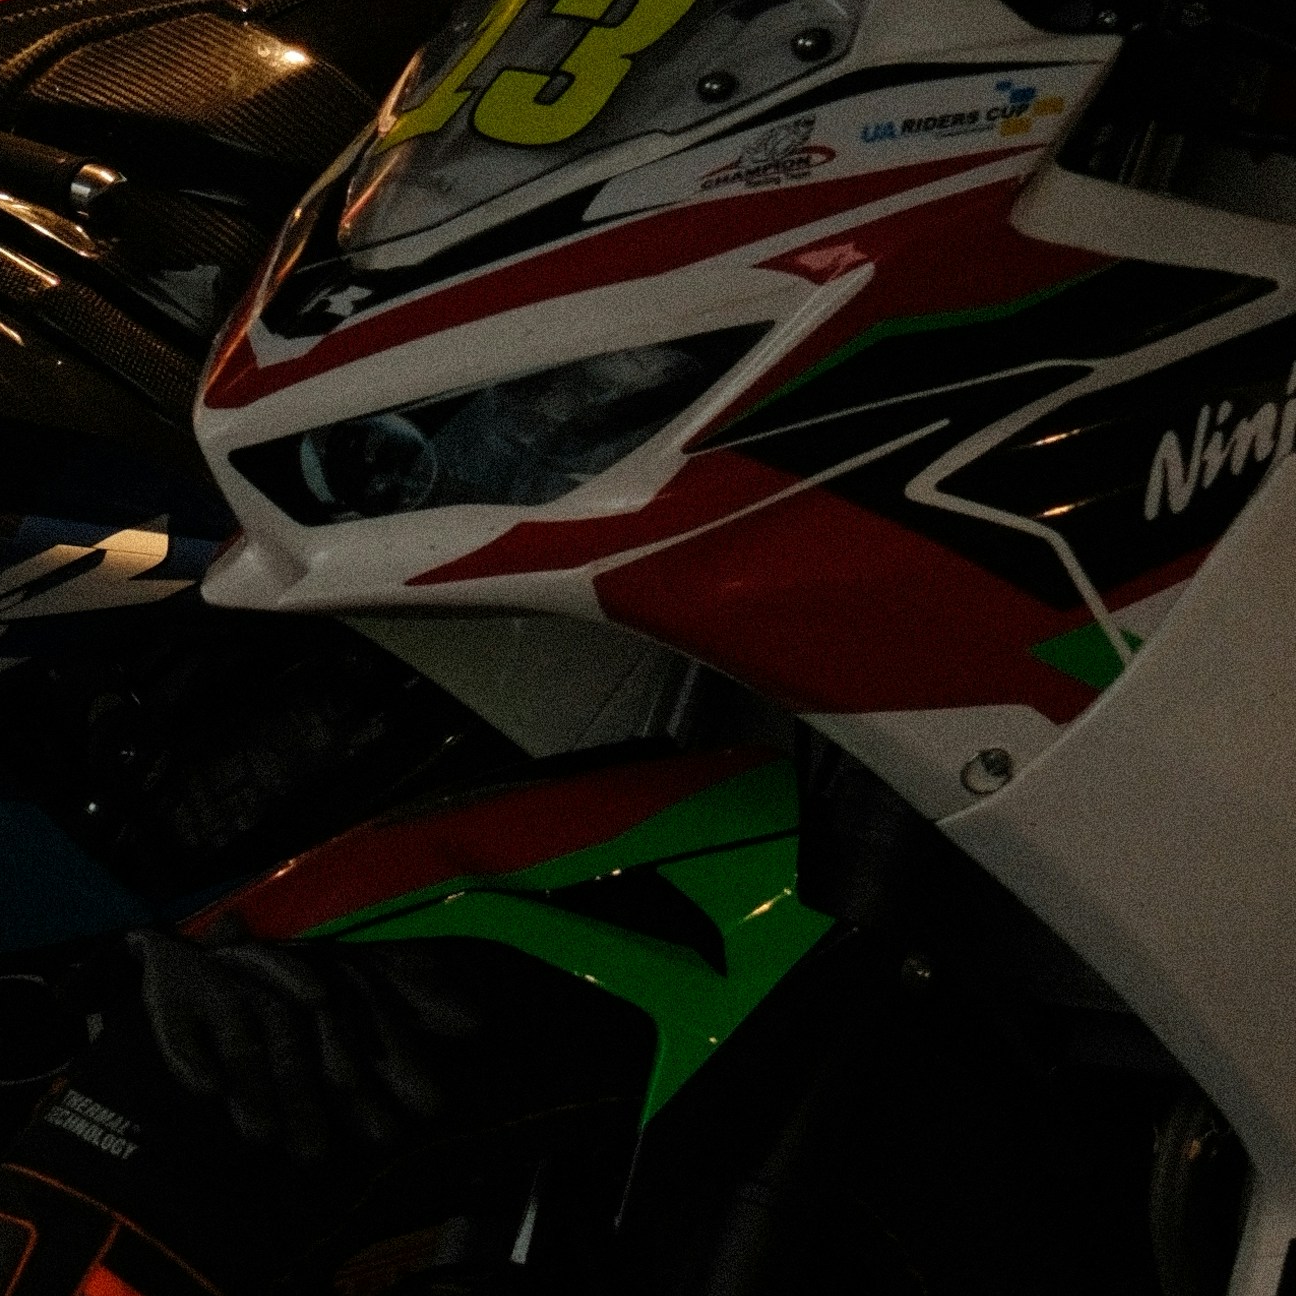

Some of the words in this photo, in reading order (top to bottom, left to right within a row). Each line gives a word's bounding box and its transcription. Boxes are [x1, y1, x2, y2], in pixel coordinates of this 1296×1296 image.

[900, 110, 980, 134] RIDERS
[986, 103, 1029, 122] CUP
[700, 154, 812, 191] CHAMPION
